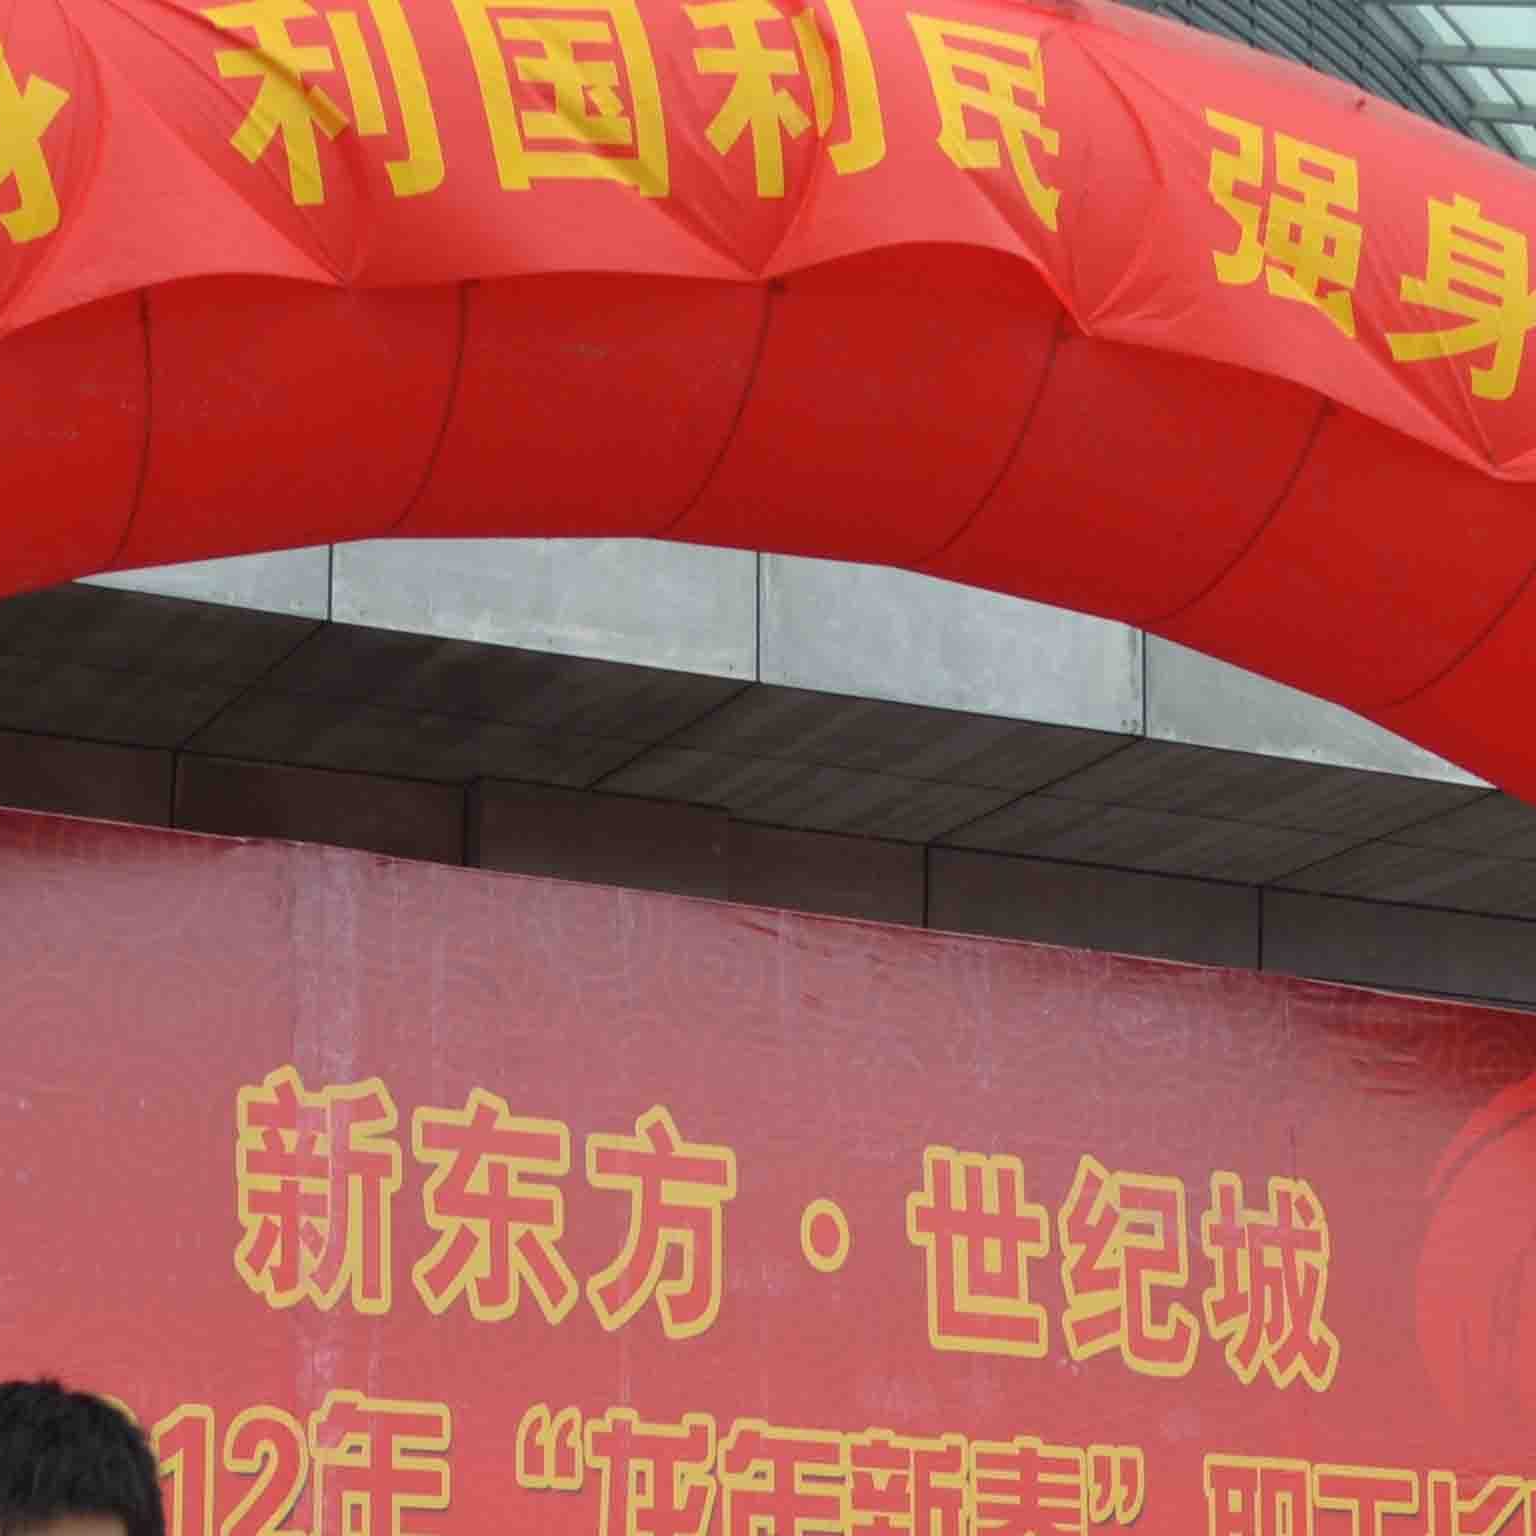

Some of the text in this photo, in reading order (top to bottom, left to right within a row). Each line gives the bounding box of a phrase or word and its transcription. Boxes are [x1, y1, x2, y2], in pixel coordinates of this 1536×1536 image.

[203, 0, 1060, 232] 利国利民
[234, 1065, 1340, 1391] 新东方·世纪城
